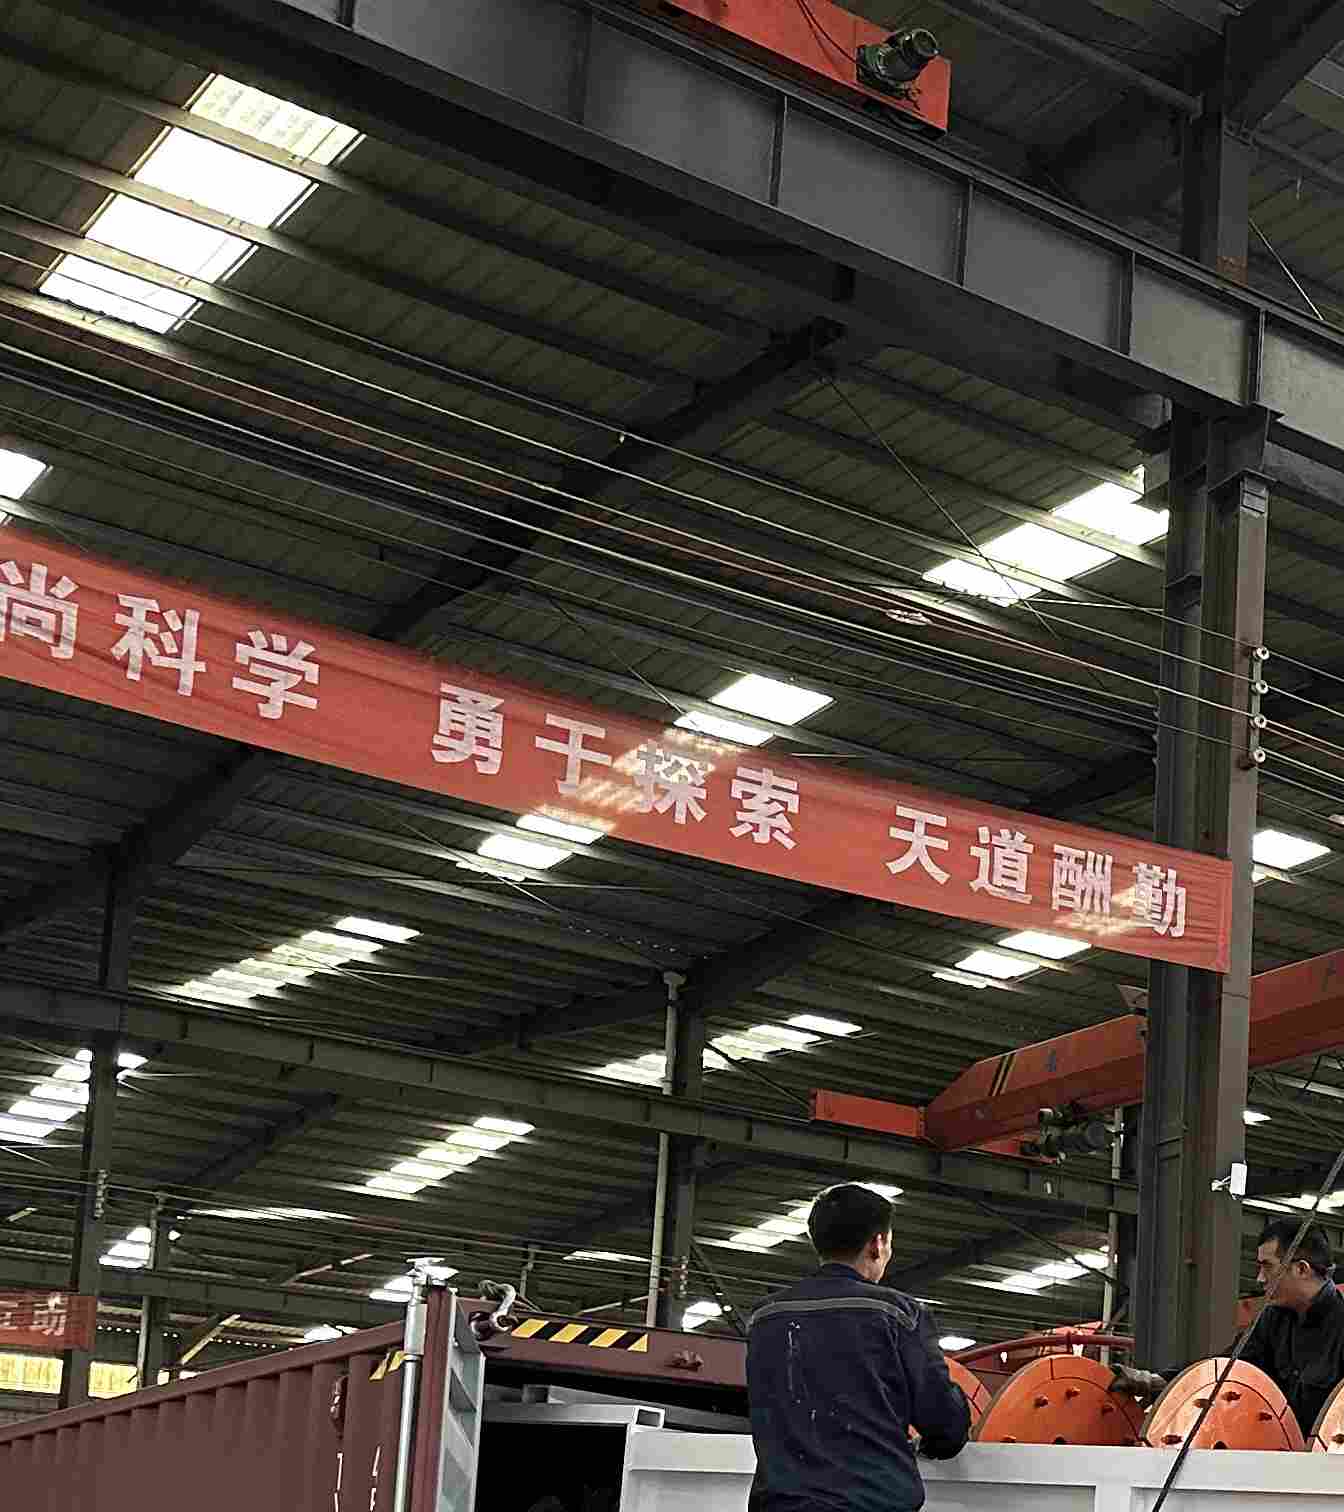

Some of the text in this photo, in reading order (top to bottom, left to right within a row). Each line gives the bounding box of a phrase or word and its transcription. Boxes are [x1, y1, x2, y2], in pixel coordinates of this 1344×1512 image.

[431, 682, 800, 850] 勇于探索
[885, 804, 1186, 937] 天道酬勤
